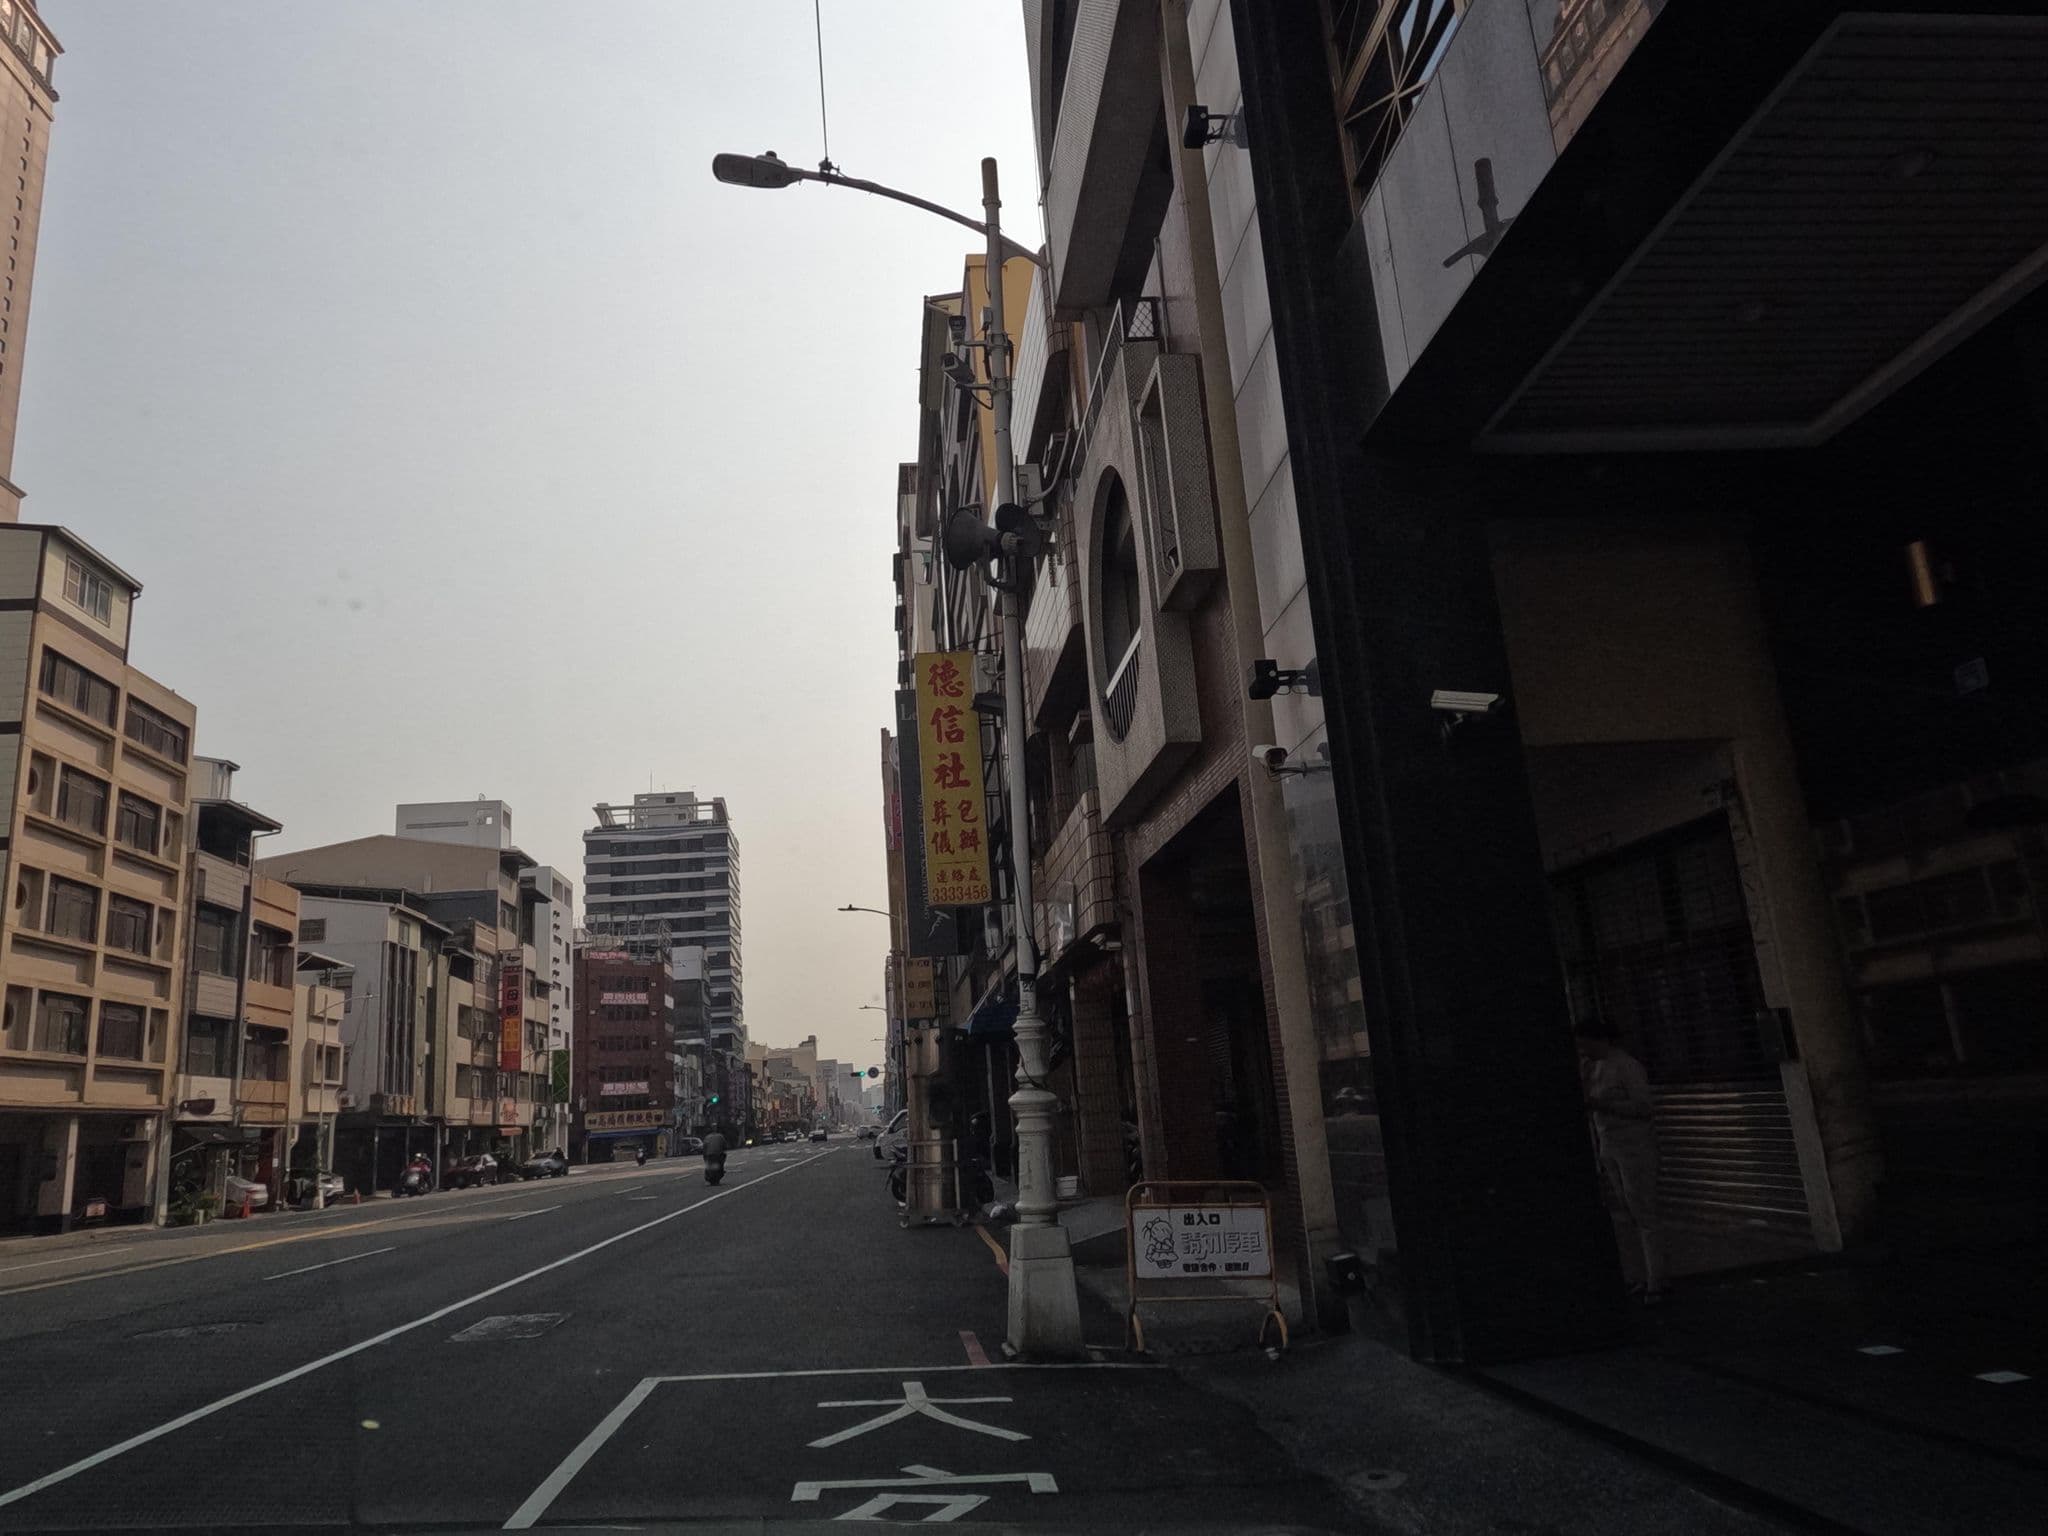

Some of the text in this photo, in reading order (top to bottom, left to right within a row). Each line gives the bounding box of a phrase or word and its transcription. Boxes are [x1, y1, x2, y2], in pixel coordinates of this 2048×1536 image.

[928, 660, 970, 788] 德信社
[931, 800, 955, 855] 葬儀
[932, 883, 989, 904] 3333456
[1183, 1213, 1220, 1226] 出入口
